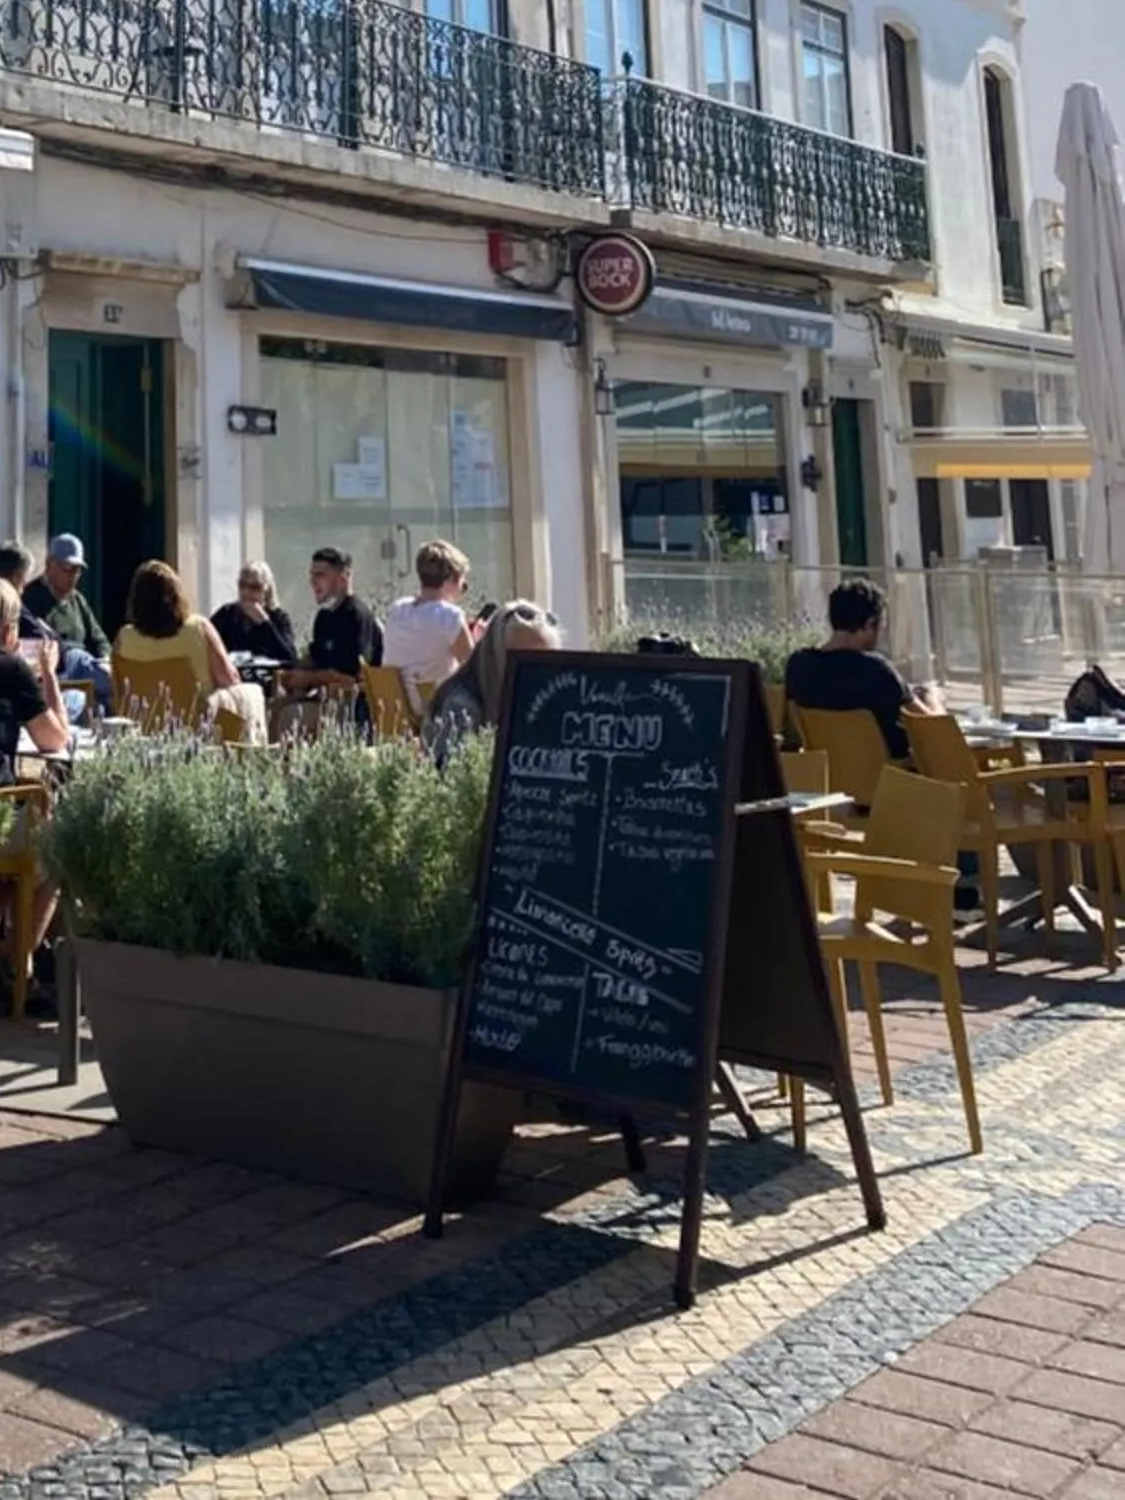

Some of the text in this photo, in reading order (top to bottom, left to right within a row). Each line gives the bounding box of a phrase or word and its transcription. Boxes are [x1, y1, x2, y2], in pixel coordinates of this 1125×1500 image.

[586, 256, 634, 276] SUPER
[587, 273, 632, 289] BOCK
[560, 710, 663, 750] MENU
